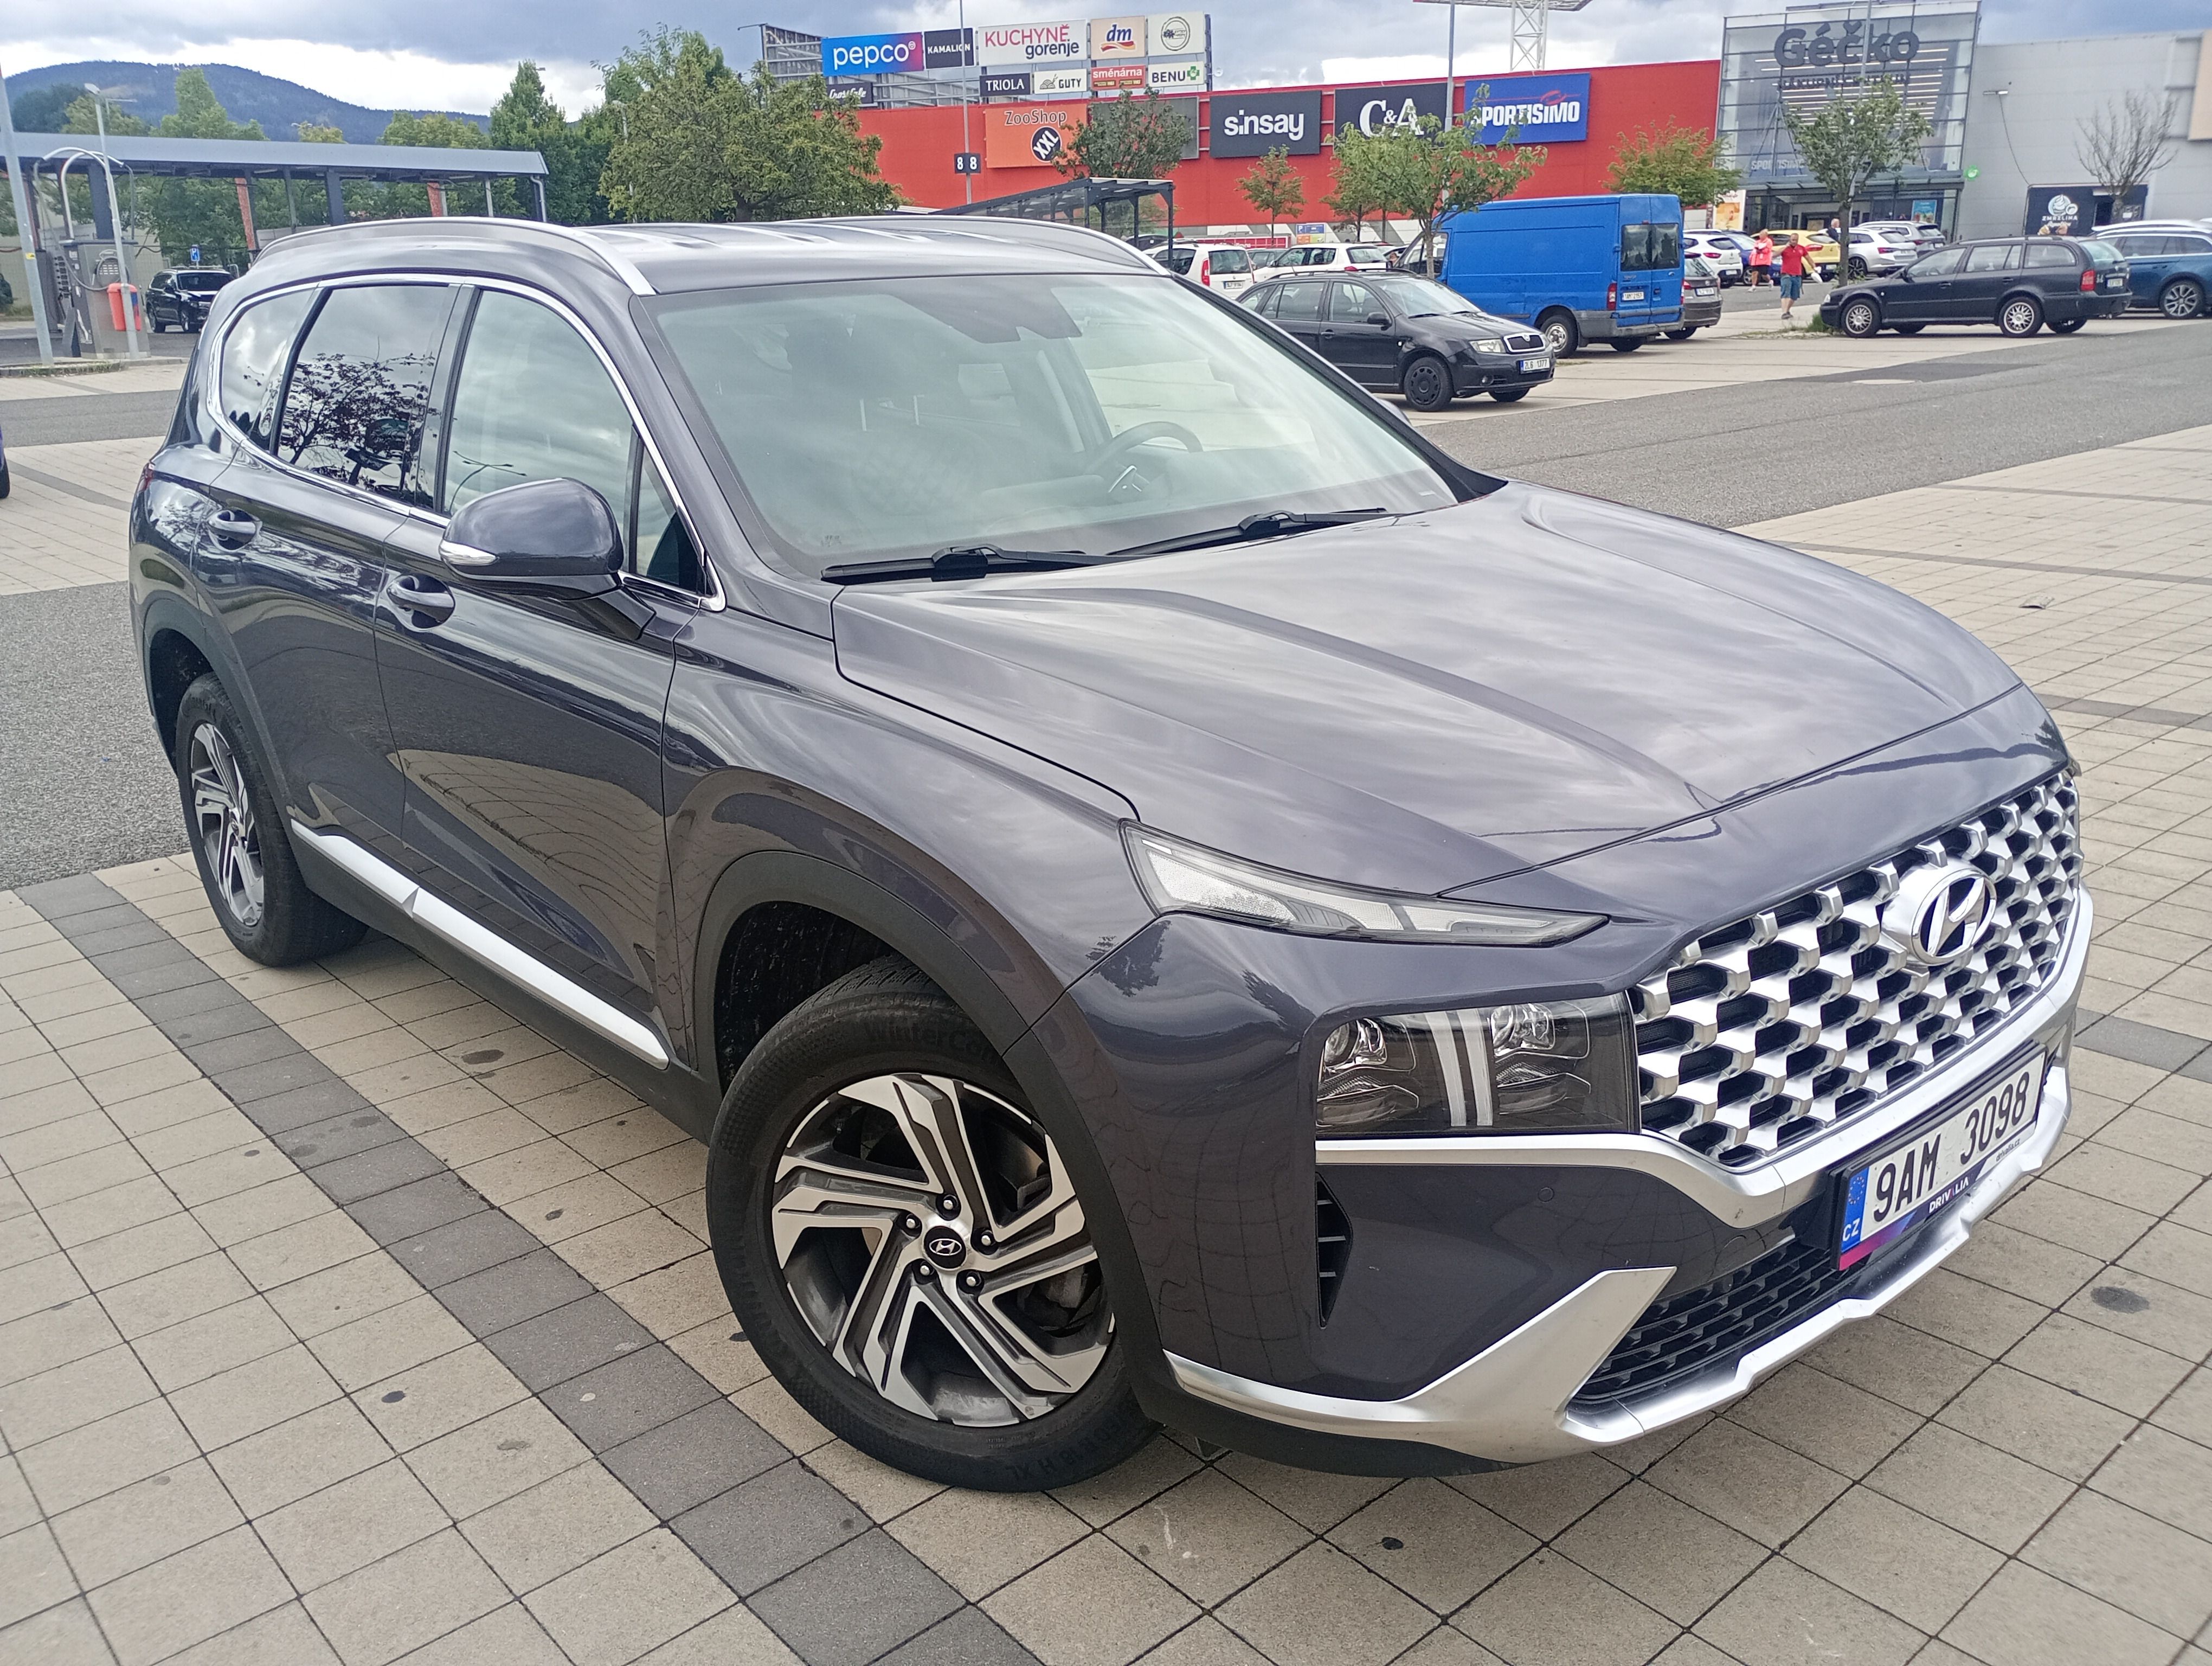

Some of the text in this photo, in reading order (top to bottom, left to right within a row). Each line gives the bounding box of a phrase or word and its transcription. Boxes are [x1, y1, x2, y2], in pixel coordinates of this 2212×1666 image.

[985, 24, 1070, 48] KUCHYNĚ
[1107, 24, 1131, 42] dm
[1774, 21, 1920, 67] Géčko
[833, 43, 910, 71] pepco
[927, 43, 970, 55] KAMALION
[1025, 39, 1079, 60] gorenje
[1058, 78, 1082, 89] GUTY
[1092, 67, 1142, 79] směnárna
[1152, 71, 1186, 83] BENU
[985, 79, 1025, 92] TRIOLA
[1005, 110, 1067, 126] ZooShop
[1224, 110, 1304, 141] sinsay
[1359, 98, 1425, 137] C&A
[1033, 130, 1059, 159] XXL
[957, 156, 977, 170] 8 8
[1874, 1071, 2030, 1222] 9AM 3098
[1996, 1138, 2021, 1162] drivalia.cz
[1928, 1176, 1969, 1214] DRIVALIA
[1842, 1217, 1860, 1242] CZ
